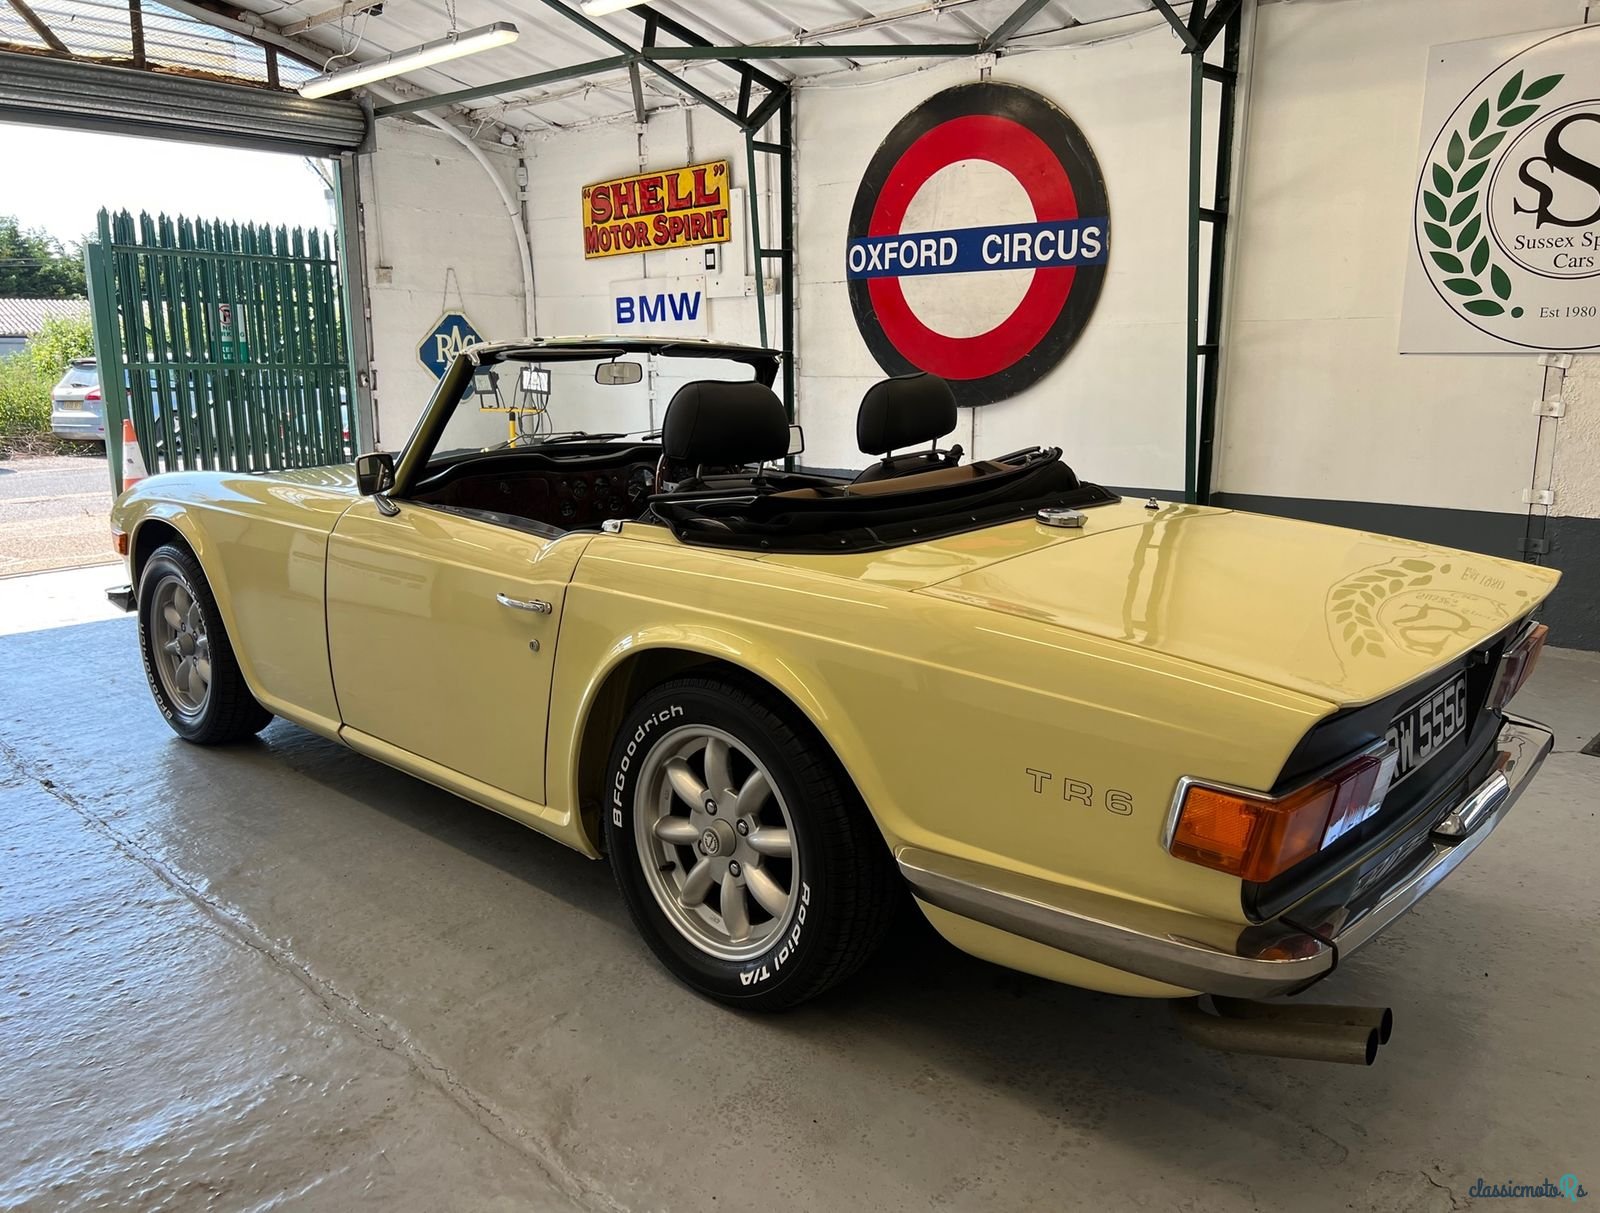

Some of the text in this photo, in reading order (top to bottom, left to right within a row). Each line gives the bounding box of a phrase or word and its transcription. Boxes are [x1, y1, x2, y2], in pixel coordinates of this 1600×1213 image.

[585, 209, 728, 254] MOTOR SPIRIT
[849, 226, 1101, 273] OXFORD CIRCUS
[1514, 235, 1574, 250] Sussex
[1553, 252, 1594, 269] Cars
[616, 291, 701, 324] BMW
[1539, 306, 1597, 318] Est 1980
[1419, 678, 1465, 758] 555G
[612, 705, 684, 828] BFGoodrich
[1026, 767, 1133, 816] TR6
[739, 882, 811, 986] Radial T/A
